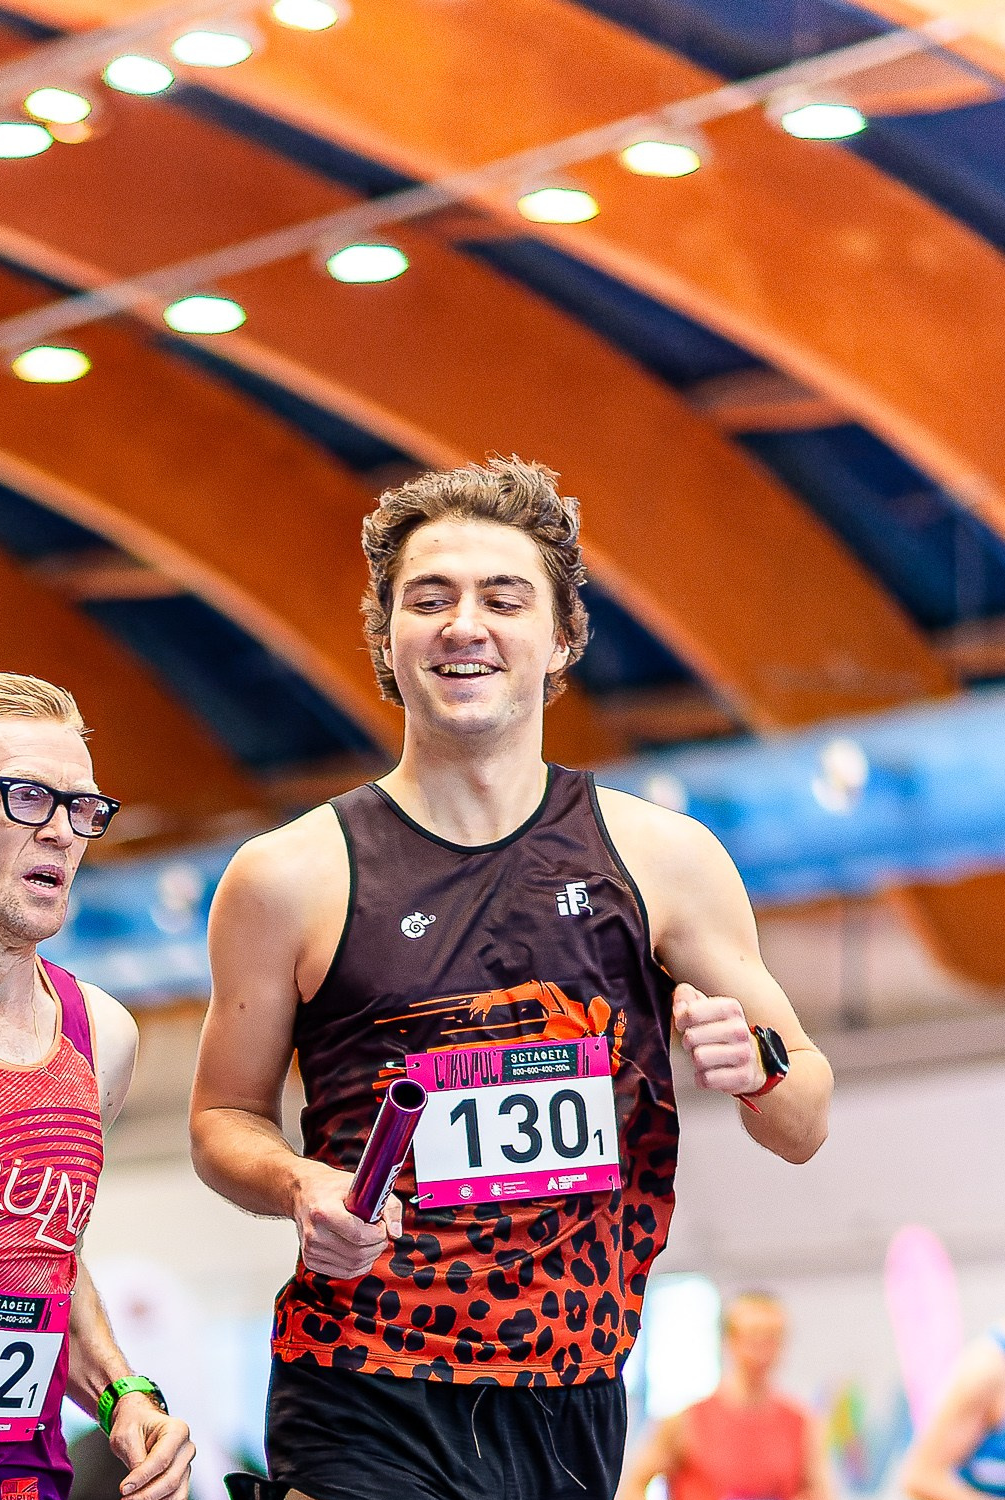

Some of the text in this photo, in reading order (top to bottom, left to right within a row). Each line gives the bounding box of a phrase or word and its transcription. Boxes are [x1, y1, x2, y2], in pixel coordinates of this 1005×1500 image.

[510, 1049, 570, 1064] ЭСТАФЕТА
[450, 1089, 605, 1168] 130 1
[26, 1382, 39, 1409] 1
